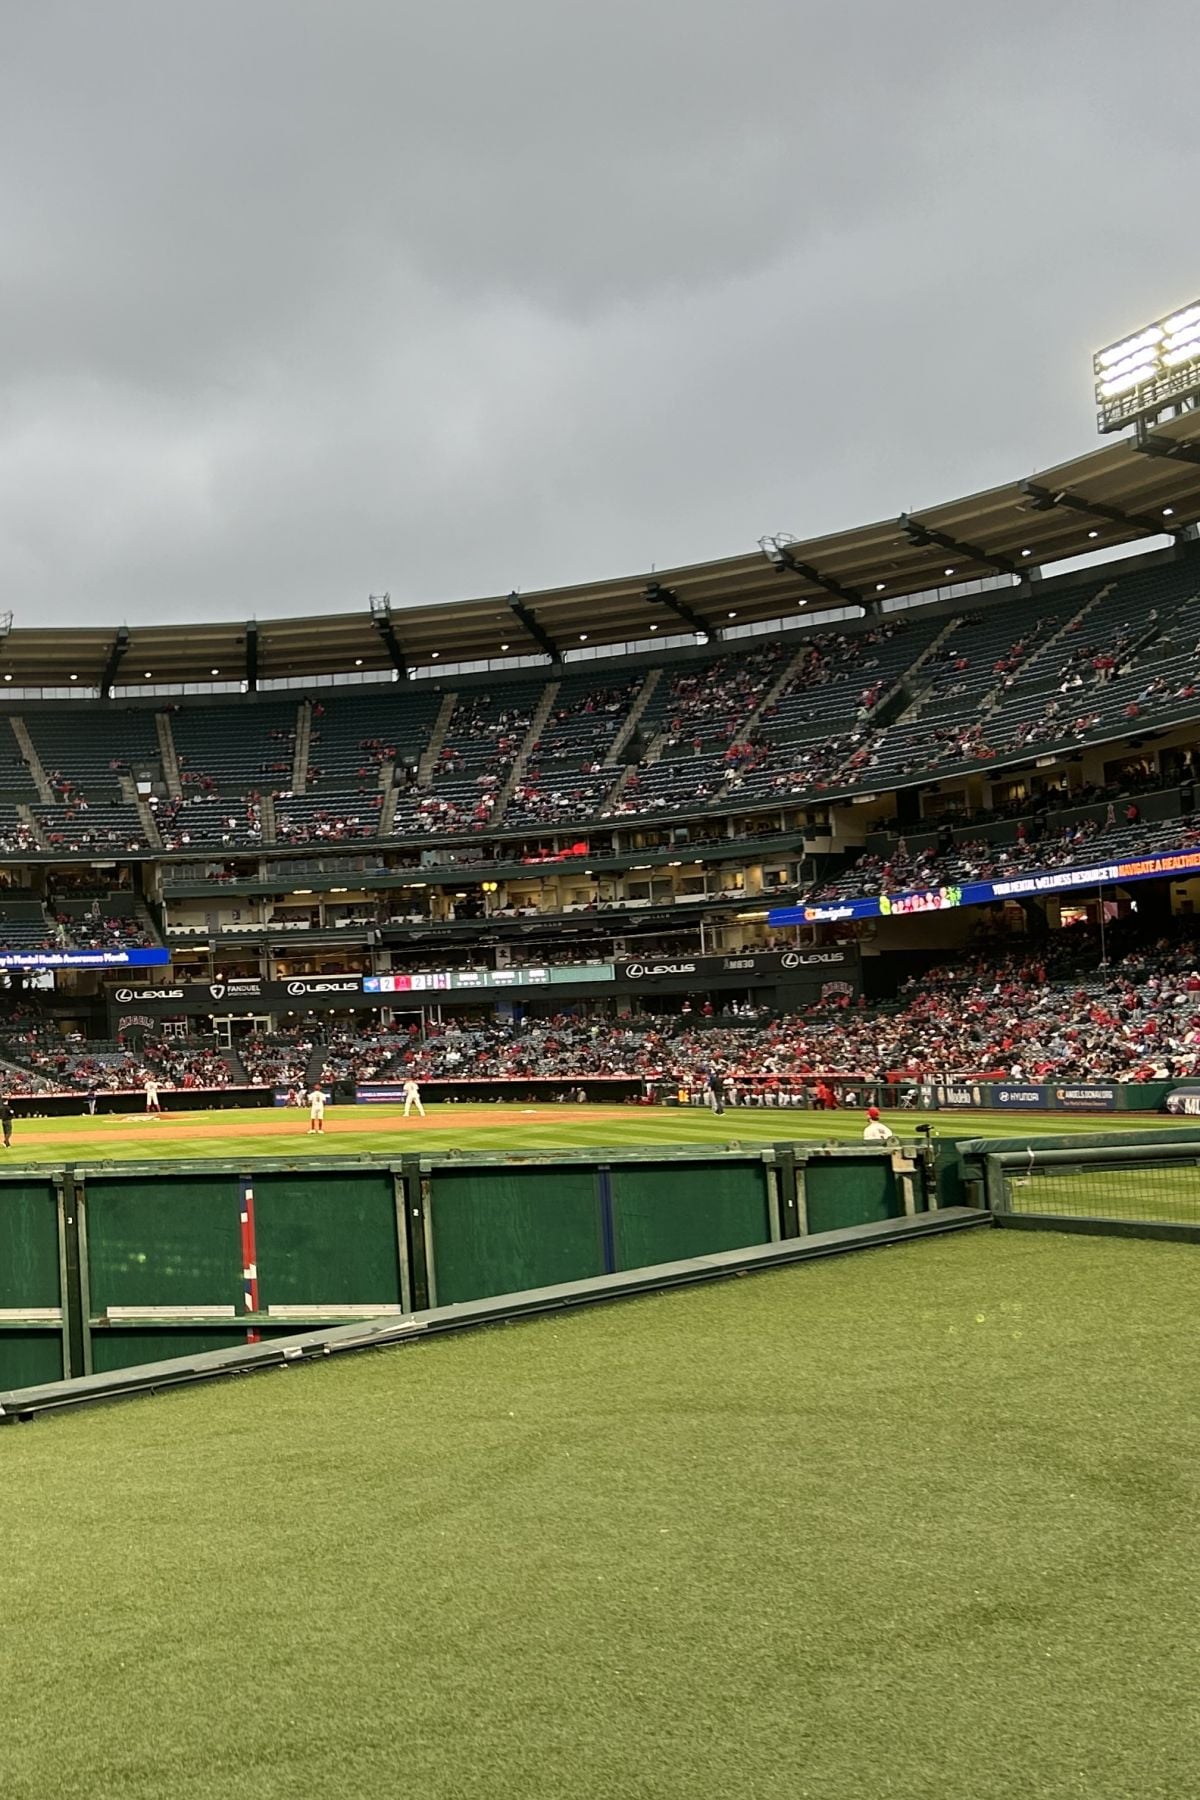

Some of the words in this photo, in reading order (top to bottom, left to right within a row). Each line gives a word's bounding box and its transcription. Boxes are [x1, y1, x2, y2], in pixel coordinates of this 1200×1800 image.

[1119, 861, 1156, 876] NAVIGATE
[14, 955, 38, 964] Mental
[39, 954, 63, 963] Health
[63, 954, 103, 963] Awareness
[104, 953, 129, 962] Month
[800, 952, 844, 964] LEXUS
[644, 964, 696, 975] LEXUS
[306, 982, 359, 993] LEXUS
[133, 989, 184, 999] LEXUS
[1010, 1092, 1039, 1101] HYUNDAI
